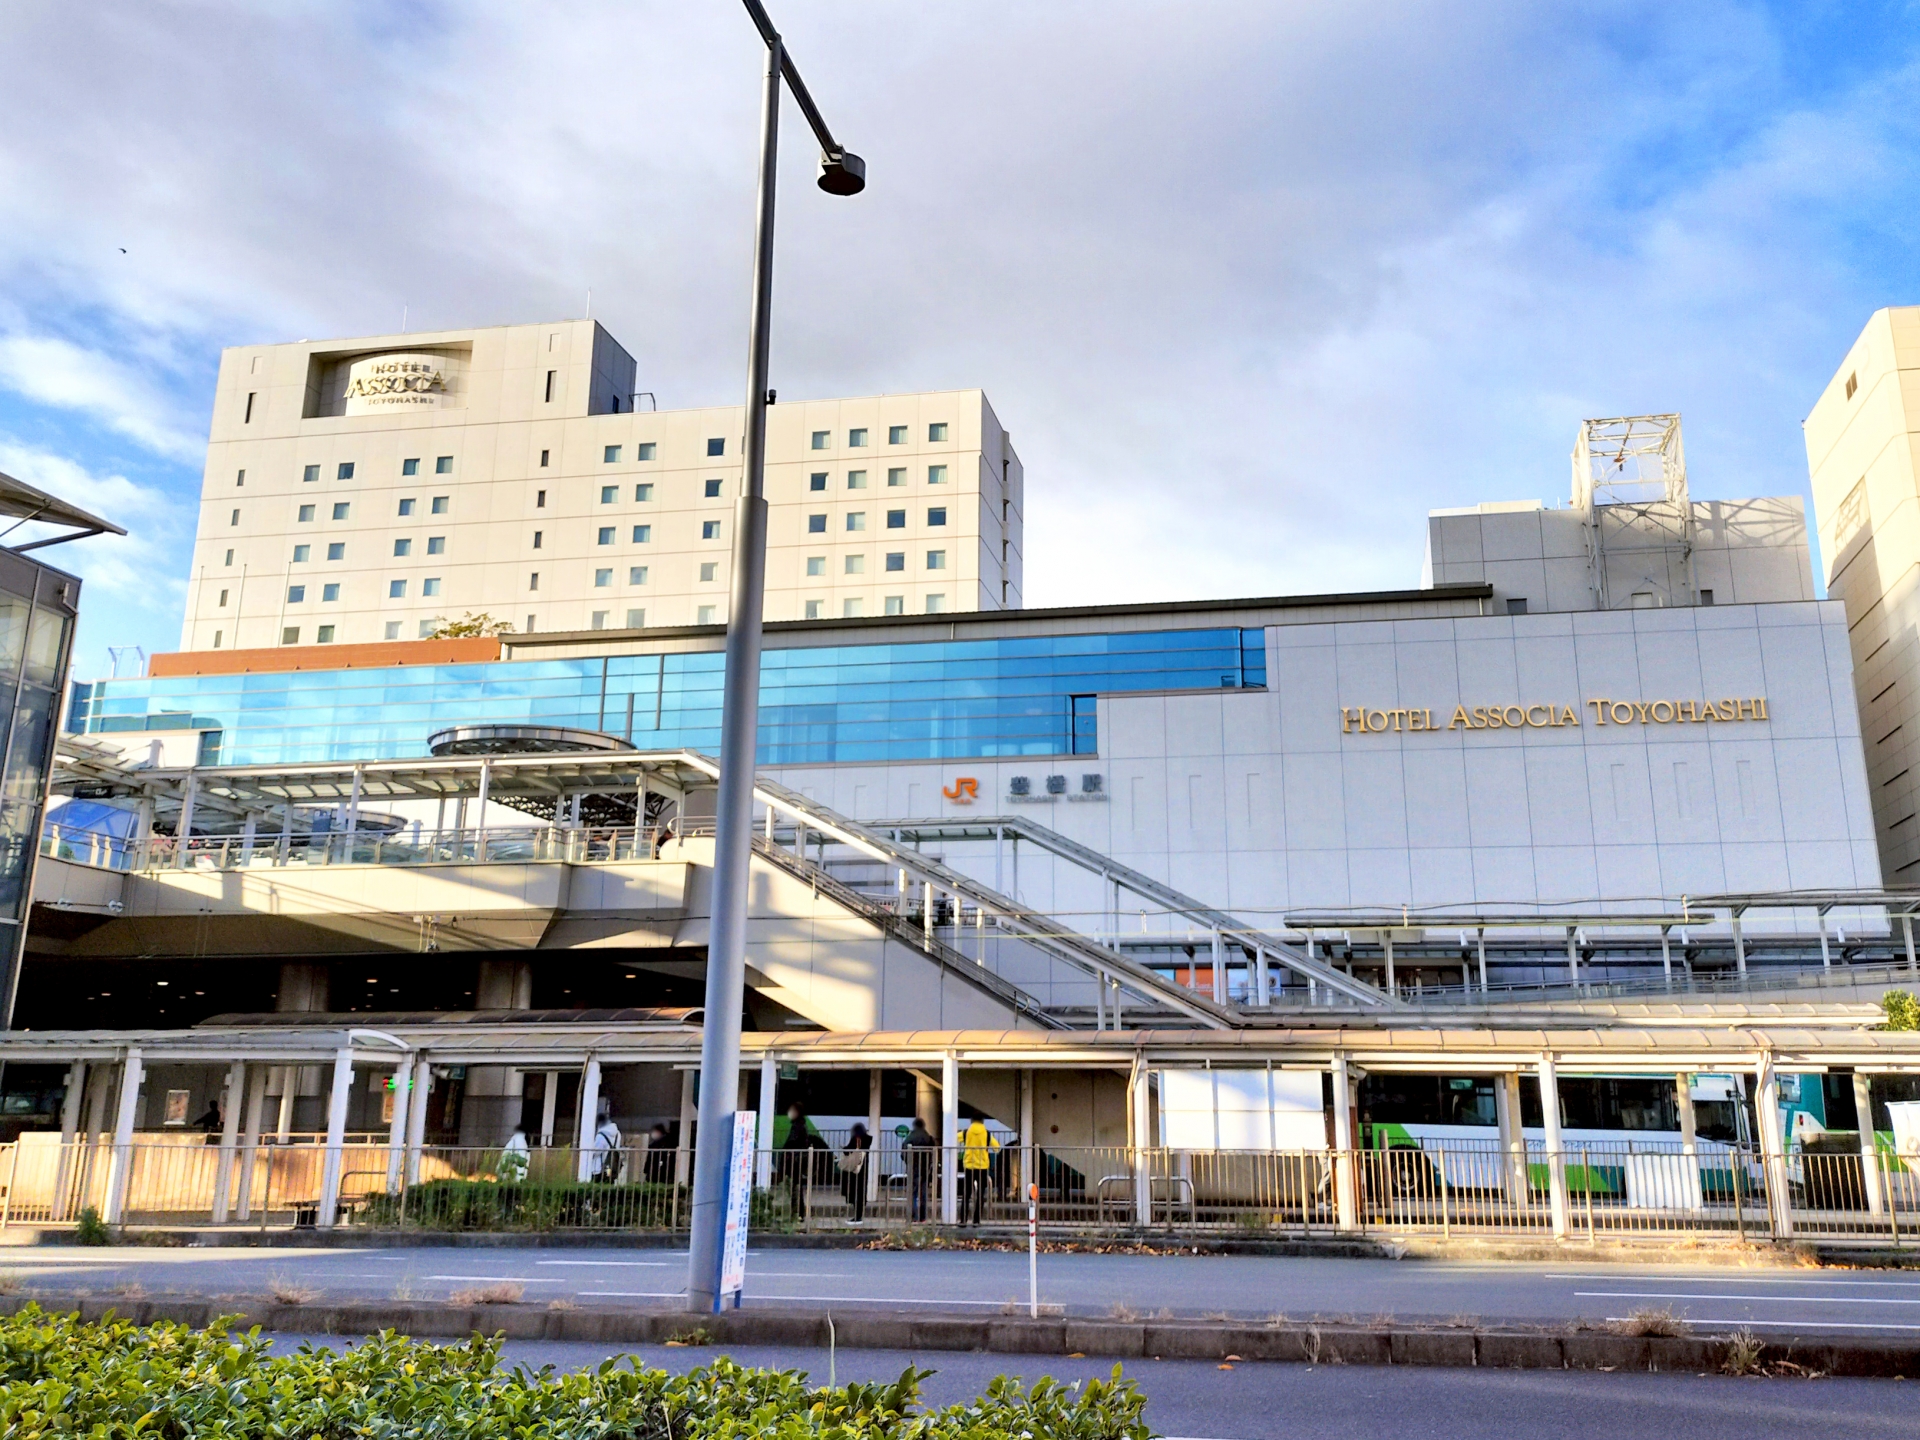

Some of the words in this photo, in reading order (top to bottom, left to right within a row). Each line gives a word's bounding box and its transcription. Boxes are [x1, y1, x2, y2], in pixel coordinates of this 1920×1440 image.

[371, 361, 427, 374] HOTEL
[343, 370, 448, 398] ASSOCIA
[943, 777, 978, 798] JR
